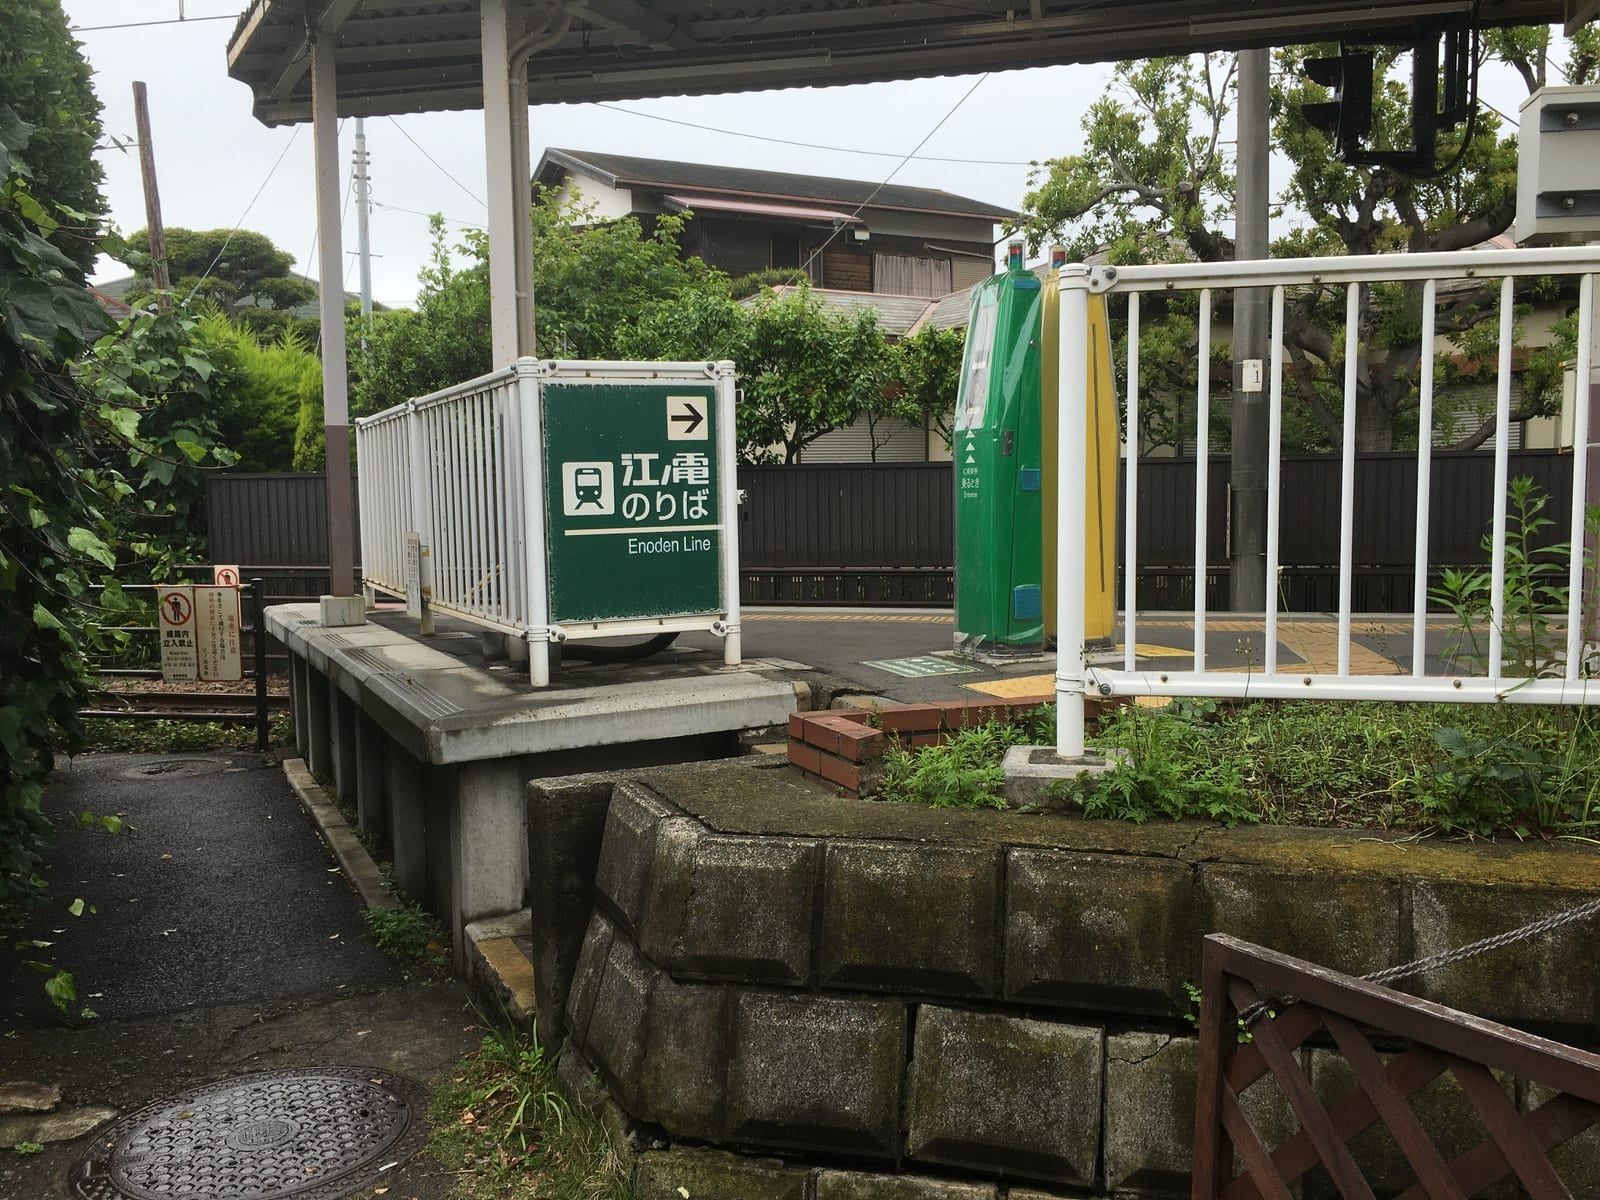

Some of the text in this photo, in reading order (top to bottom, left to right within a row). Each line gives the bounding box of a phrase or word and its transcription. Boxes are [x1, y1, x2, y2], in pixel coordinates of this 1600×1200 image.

[621, 453, 709, 486] 江ノ電
[621, 488, 709, 521] のりば
[628, 536, 711, 554] Enoden Line
[163, 639, 193, 648] 立入禁止
